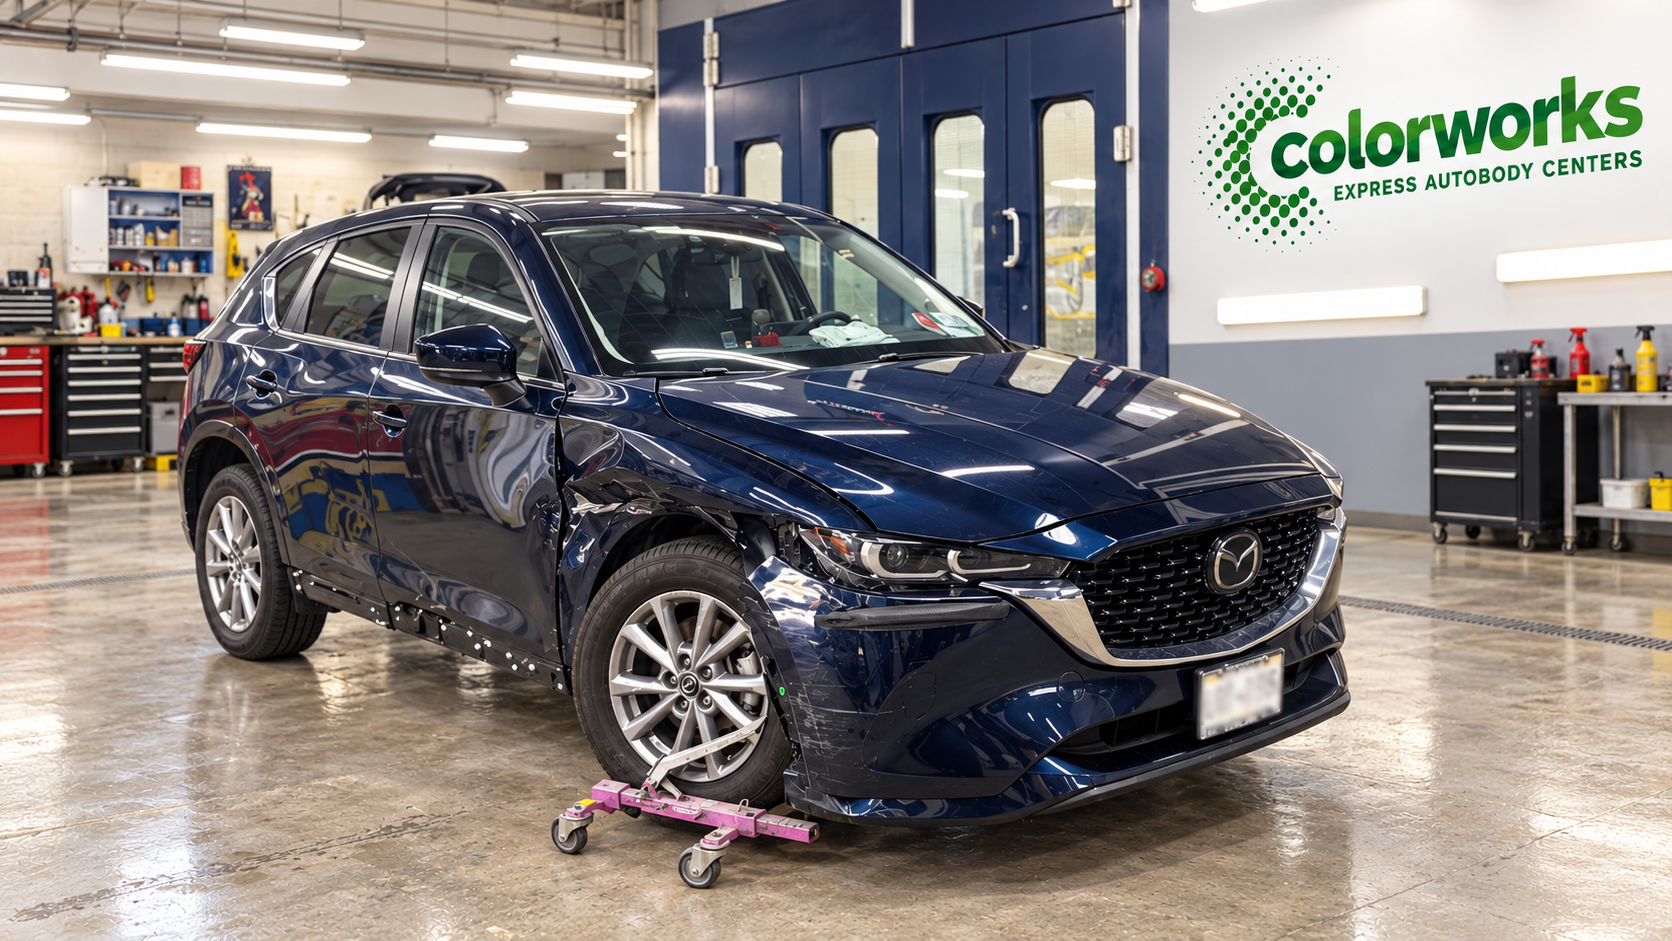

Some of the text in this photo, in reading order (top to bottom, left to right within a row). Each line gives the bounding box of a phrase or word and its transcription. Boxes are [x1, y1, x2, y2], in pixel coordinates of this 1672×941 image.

[1334, 150, 1643, 201] EXPRESS AUTOBODY CENTERS
